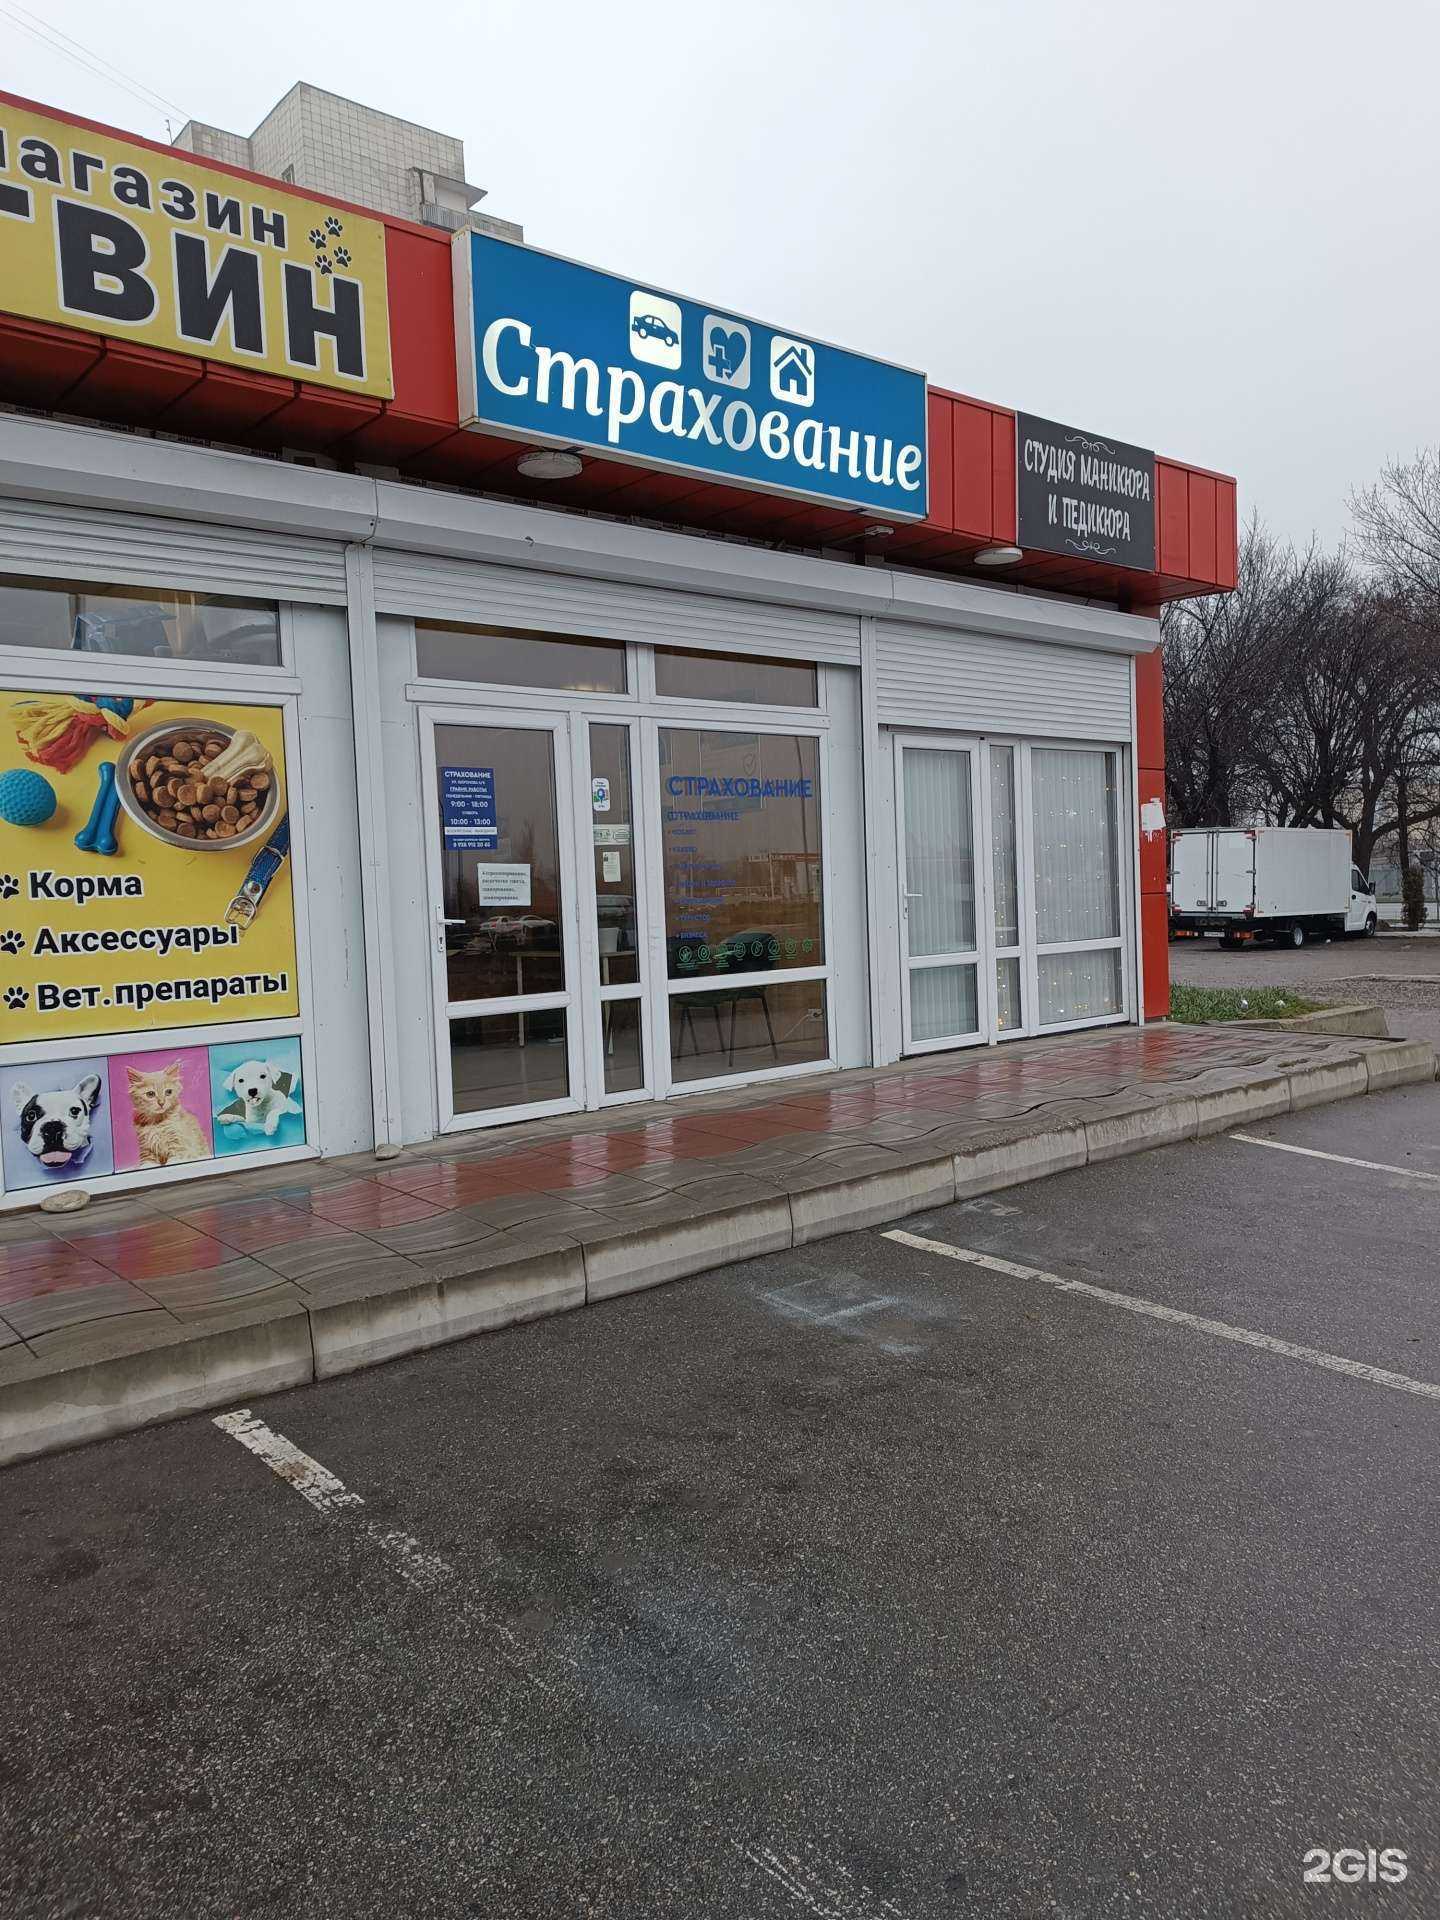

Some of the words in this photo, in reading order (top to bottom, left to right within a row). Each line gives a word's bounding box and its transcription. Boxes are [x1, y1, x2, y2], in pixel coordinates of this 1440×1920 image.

[0, 128, 287, 250] агазин
[482, 317, 922, 491] Страхование
[1024, 438, 1076, 484] СТУДИЯ
[1080, 454, 1150, 501] МАНИКЮРА
[1048, 493, 1057, 525] И
[1062, 497, 1131, 541] ПЕДИКЮРА
[444, 771, 492, 779] СТРАХОВАНИЕ
[667, 776, 814, 798] СТРАХОВАНИЕ
[29, 871, 142, 904] Корма
[34, 924, 239, 955] Аксессуары
